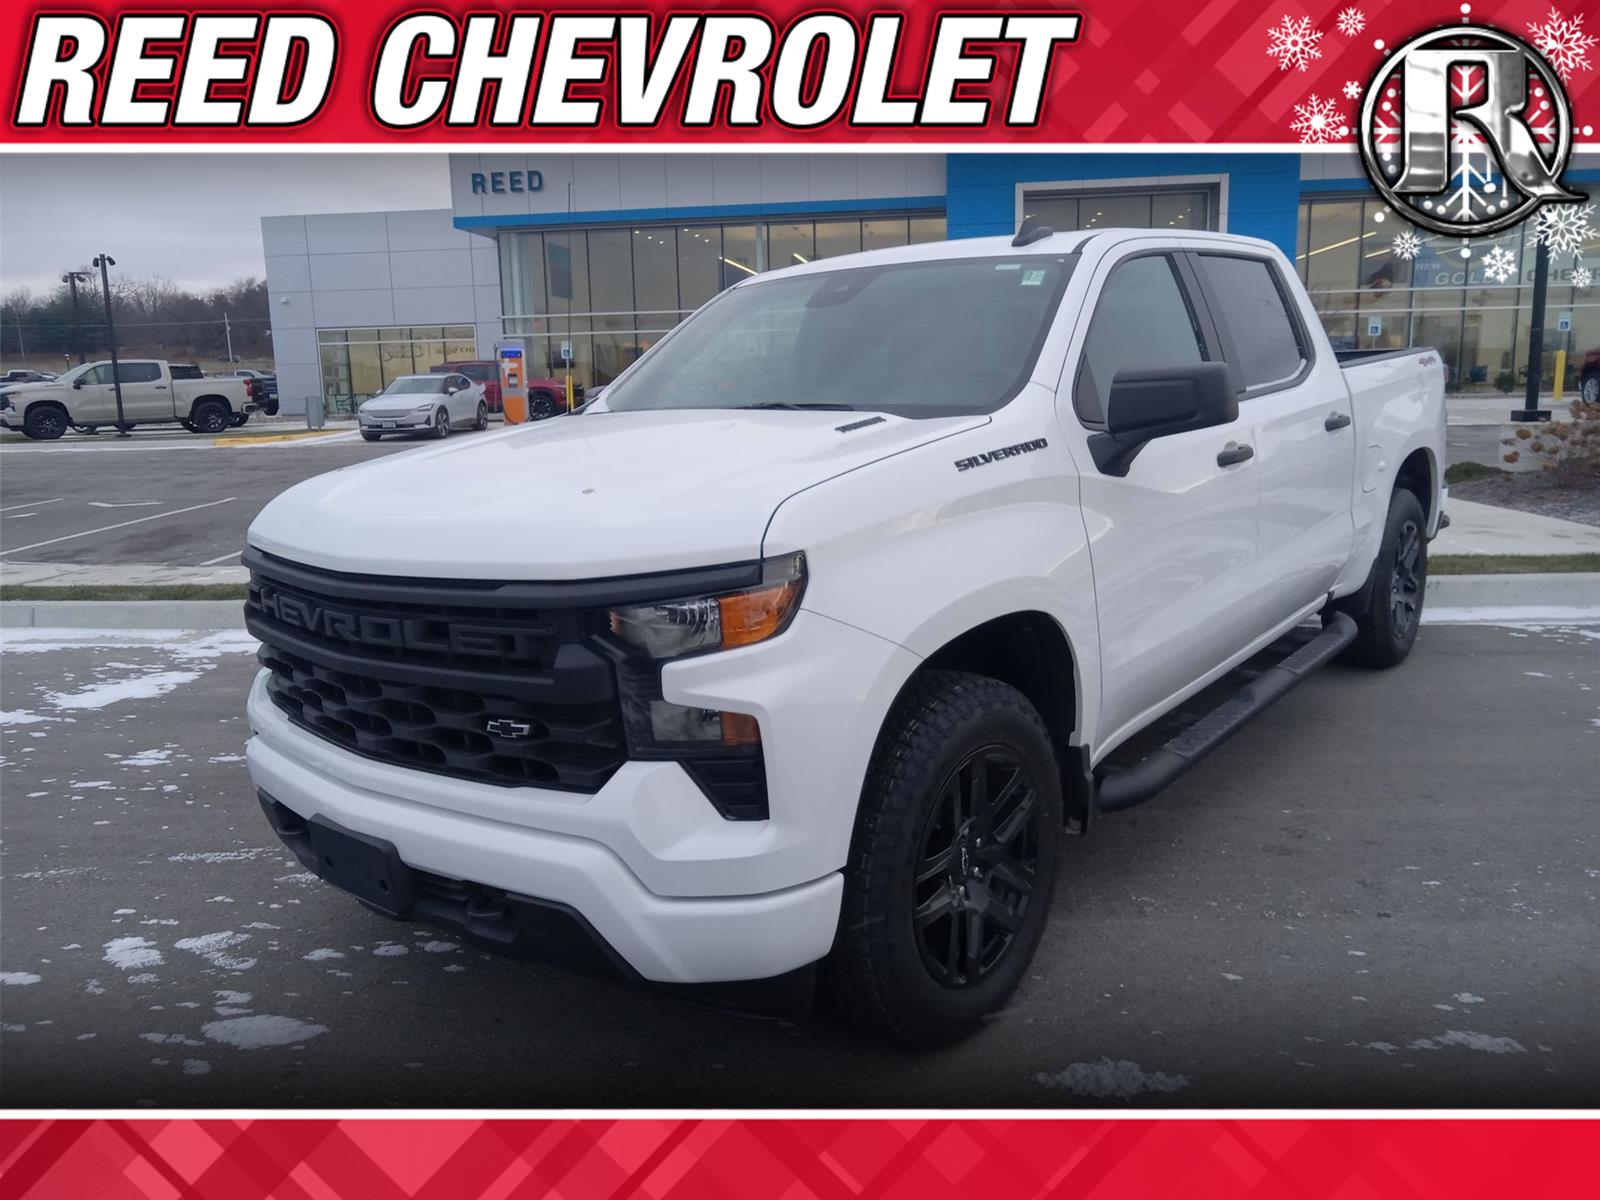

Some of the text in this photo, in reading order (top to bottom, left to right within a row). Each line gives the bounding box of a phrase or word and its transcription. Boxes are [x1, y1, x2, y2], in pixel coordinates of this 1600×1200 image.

[471, 169, 544, 194] REED
[954, 437, 1048, 472] SILVERADO
[248, 583, 557, 659] CHEVROLET
